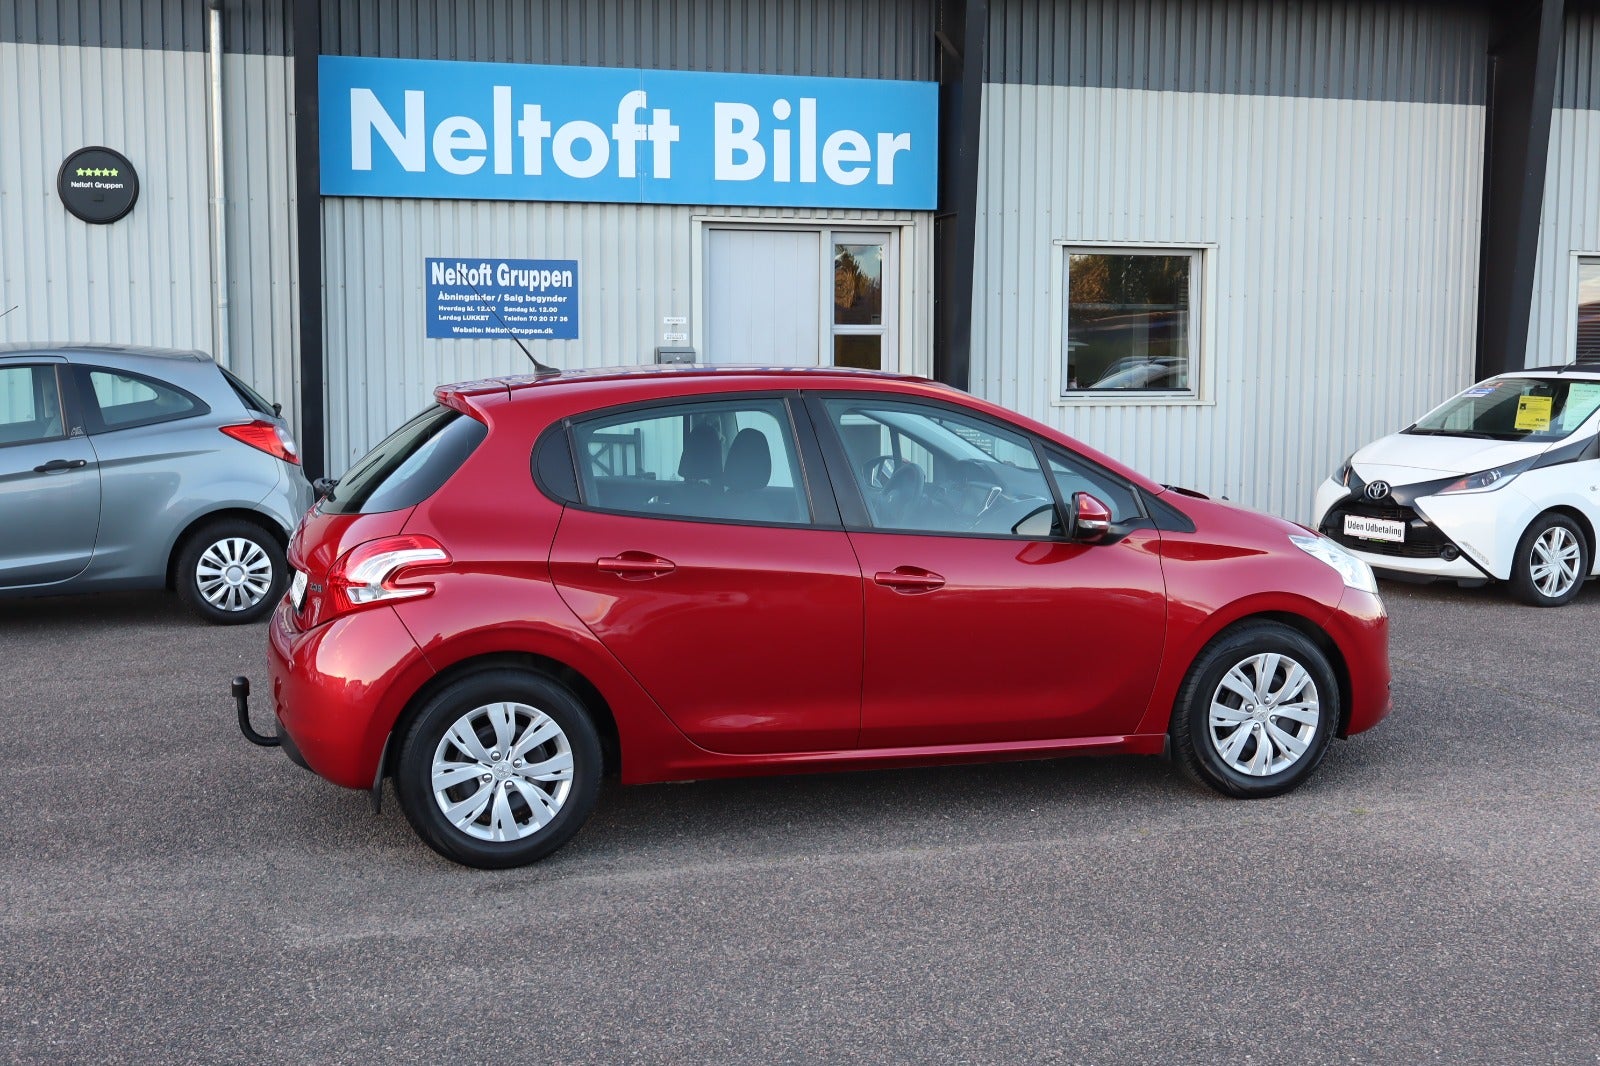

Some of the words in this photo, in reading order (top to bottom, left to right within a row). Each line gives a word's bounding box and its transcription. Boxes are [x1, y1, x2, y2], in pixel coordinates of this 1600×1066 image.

[350, 85, 680, 180] Neltoft
[714, 97, 911, 186] Biler
[70, 181, 94, 189] Neltoft
[94, 181, 124, 190] Gruppen
[431, 261, 492, 286] Neltoft
[496, 262, 573, 292] Gruppen
[437, 290, 496, 303] Åbningstider
[503, 293, 524, 304] Salg
[525, 294, 568, 304] begynder
[438, 305, 466, 313] Hverdag
[438, 314, 462, 322] Lørdag
[452, 326, 484, 334] Website:
[1347, 520, 1364, 531] Uden
[1365, 522, 1402, 537] Udbetaling
